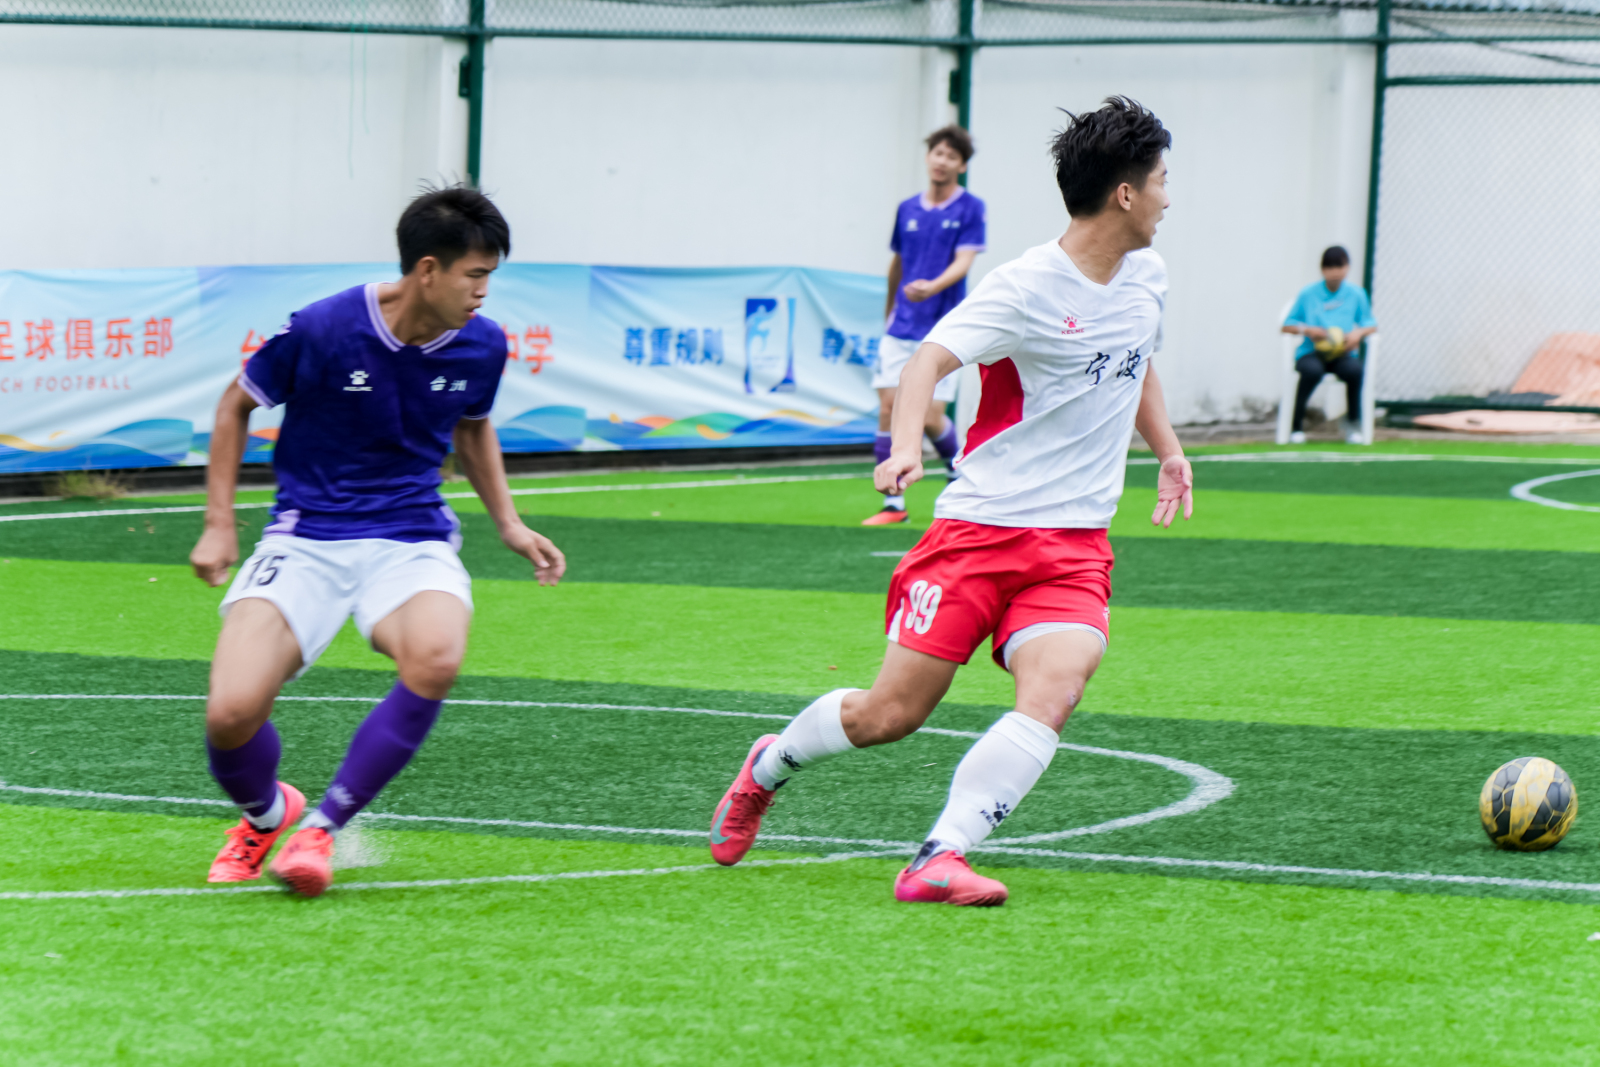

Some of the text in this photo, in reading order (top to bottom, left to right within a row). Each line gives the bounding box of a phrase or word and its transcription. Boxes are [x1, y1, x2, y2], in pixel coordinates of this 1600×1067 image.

[34, 375, 131, 393] FOOTBALL
[1085, 348, 1141, 386] 宁波
[240, 555, 289, 592] 15
[905, 580, 943, 635] 99
